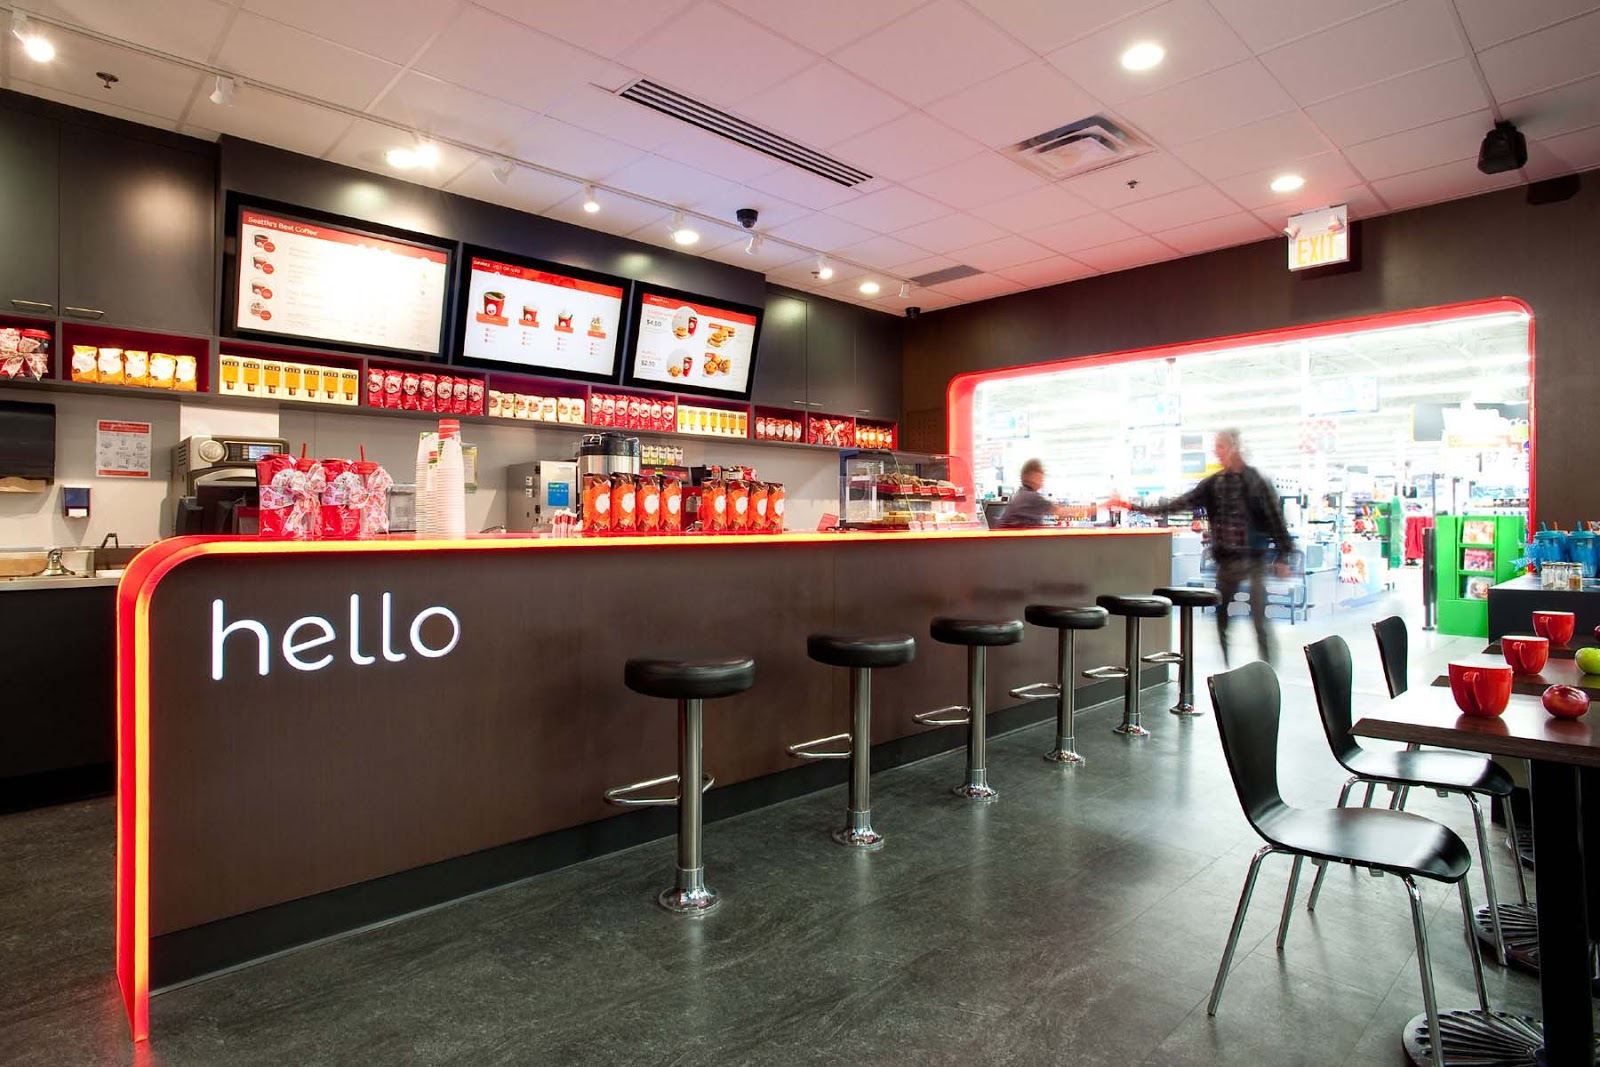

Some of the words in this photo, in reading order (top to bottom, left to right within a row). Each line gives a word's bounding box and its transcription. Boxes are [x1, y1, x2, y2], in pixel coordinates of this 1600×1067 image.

[248, 216, 278, 229] Seattle's
[278, 222, 295, 232] Best
[295, 226, 319, 236] Coffee
[1298, 232, 1337, 265] EXIT
[212, 592, 461, 681] hello
